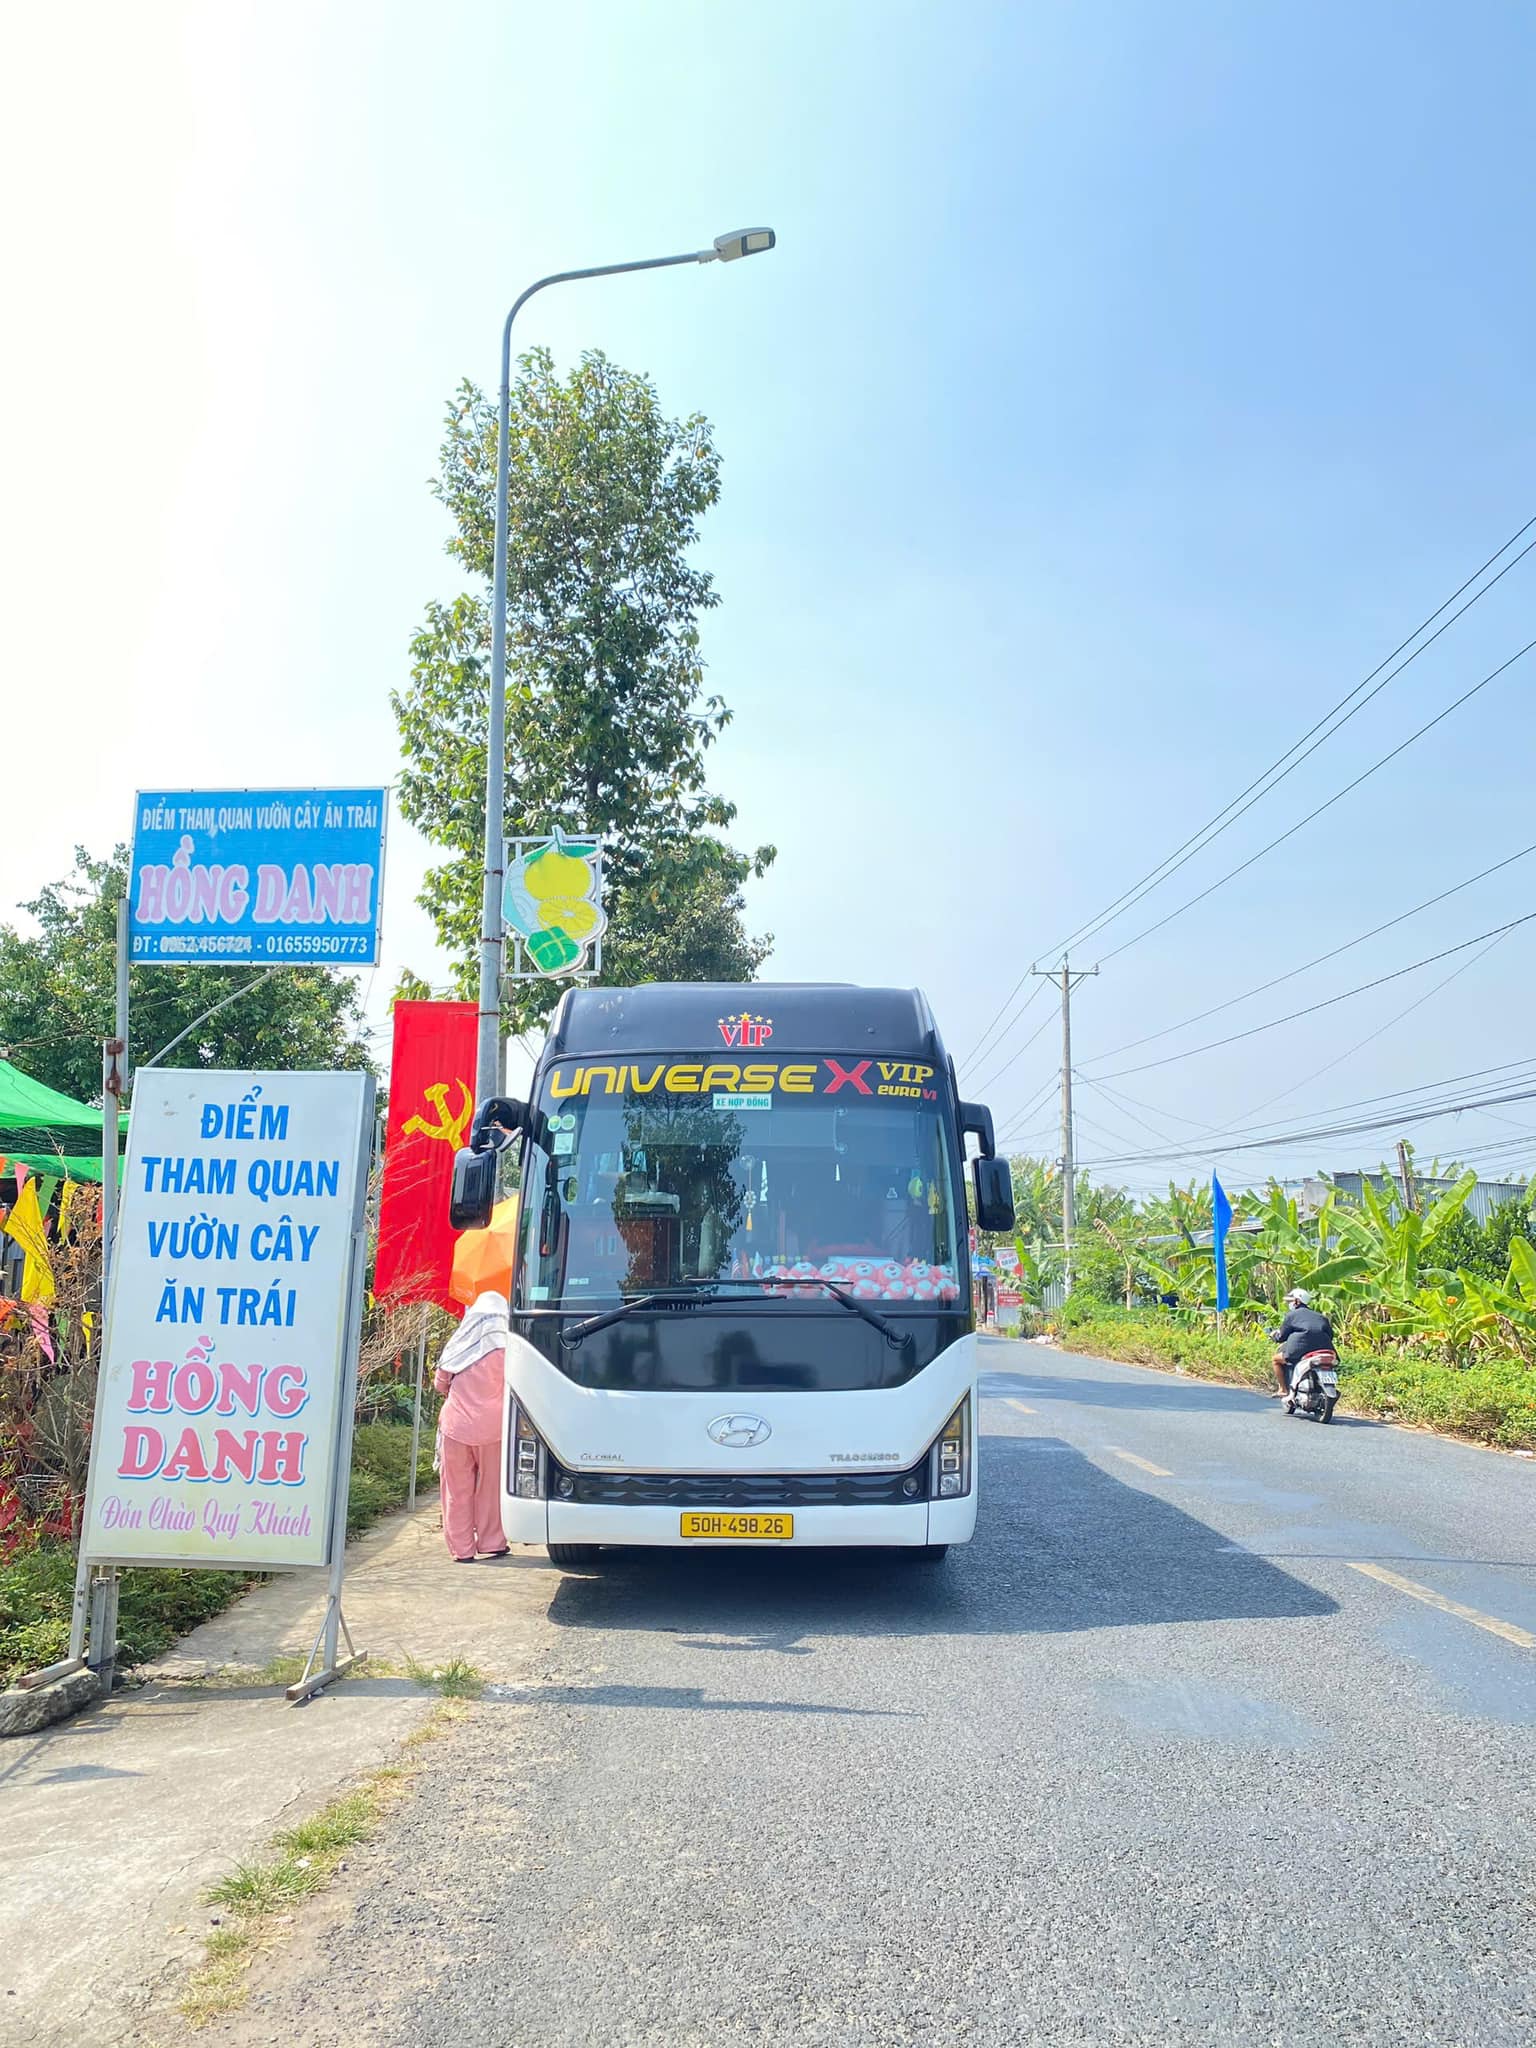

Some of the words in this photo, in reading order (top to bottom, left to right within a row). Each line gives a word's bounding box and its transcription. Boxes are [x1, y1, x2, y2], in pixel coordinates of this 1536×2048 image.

[142, 797, 175, 830] ĐIỂM
[179, 807, 215, 831] THAM
[218, 806, 251, 833] QUAN
[256, 801, 292, 830] VƯỜN
[294, 801, 321, 829] CÂY
[324, 801, 344, 828] ĂN
[347, 800, 377, 829] TRÁI
[136, 834, 249, 924] HỒNG
[252, 863, 374, 924] DANH
[266, 935, 368, 954] 01655950773
[718, 1019, 773, 1047] VIP
[823, 1059, 874, 1096] X
[877, 1062, 934, 1084] VIP
[200, 1085, 290, 1141] ĐIỂM
[141, 1156, 238, 1196] THAM
[248, 1158, 340, 1203] QUAN
[148, 1212, 239, 1260] VƯỜN
[250, 1214, 320, 1262] CÂY
[155, 1278, 205, 1324] ĂN
[216, 1278, 297, 1327] TRÁI
[126, 1335, 311, 1419] HỒNG
[117, 1425, 309, 1486] DANH
[101, 1494, 142, 1530] Đón
[148, 1496, 197, 1533] Chào
[201, 1498, 242, 1541] Quý
[246, 1500, 312, 1538] Khách
[691, 1516, 784, 1534] 50H-498.26
